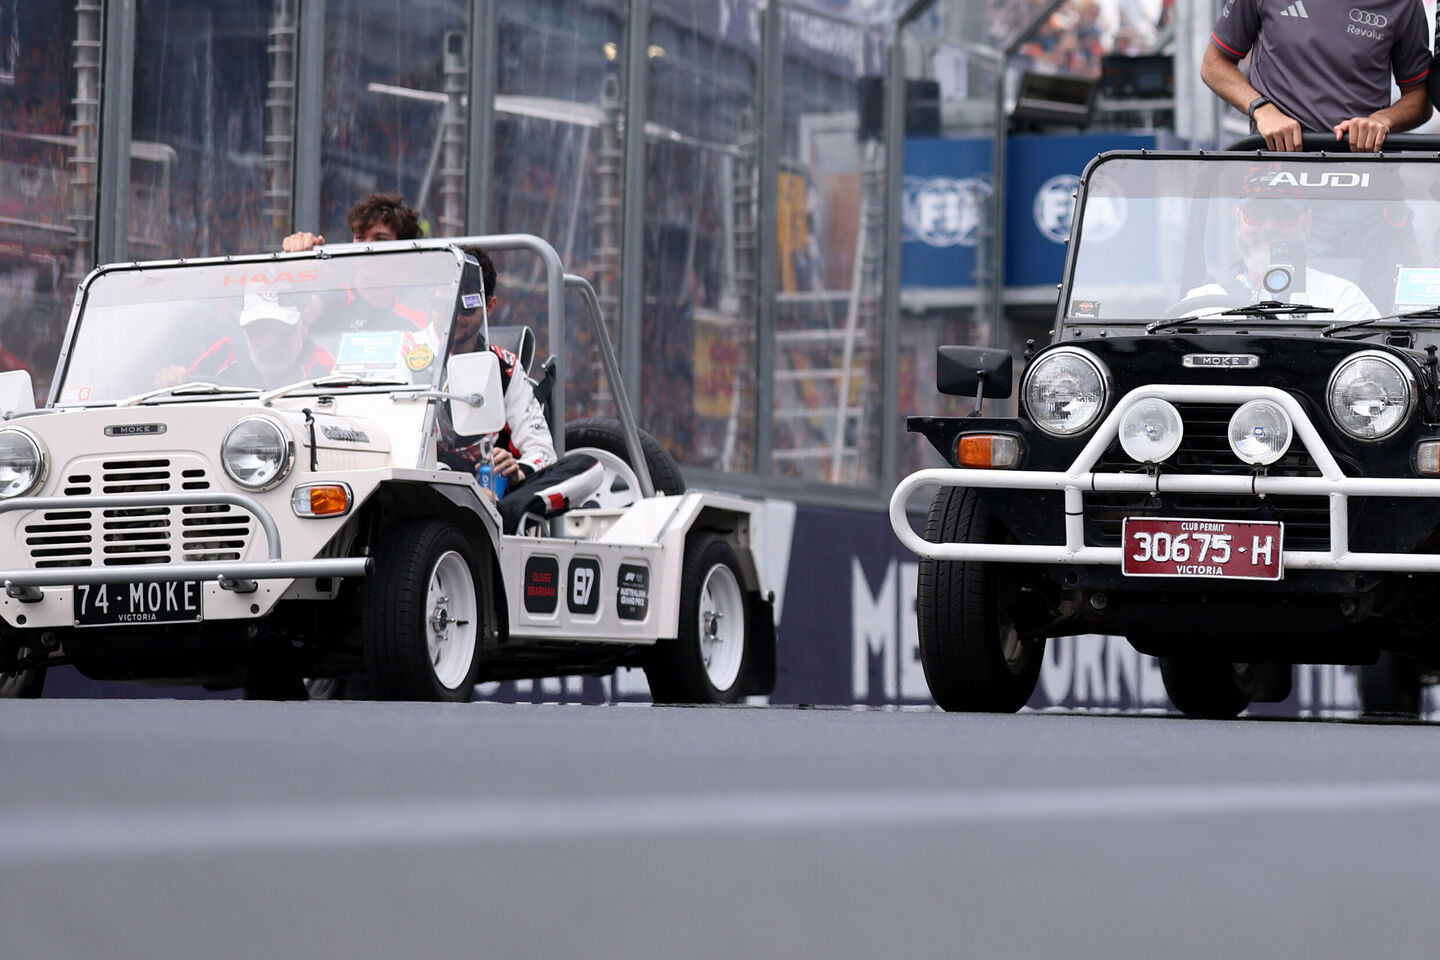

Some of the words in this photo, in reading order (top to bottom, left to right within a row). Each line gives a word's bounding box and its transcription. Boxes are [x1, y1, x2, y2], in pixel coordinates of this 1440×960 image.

[1269, 171, 1371, 187] AUDI
[223, 270, 319, 287] HAAS
[1202, 357, 1239, 365] MOKE
[1181, 522, 1198, 530] CLUB
[1200, 523, 1225, 532] PERMIT
[1176, 565, 1224, 576] VICTORIA
[573, 567, 595, 606] 87
[118, 613, 157, 622] VICTORIA
